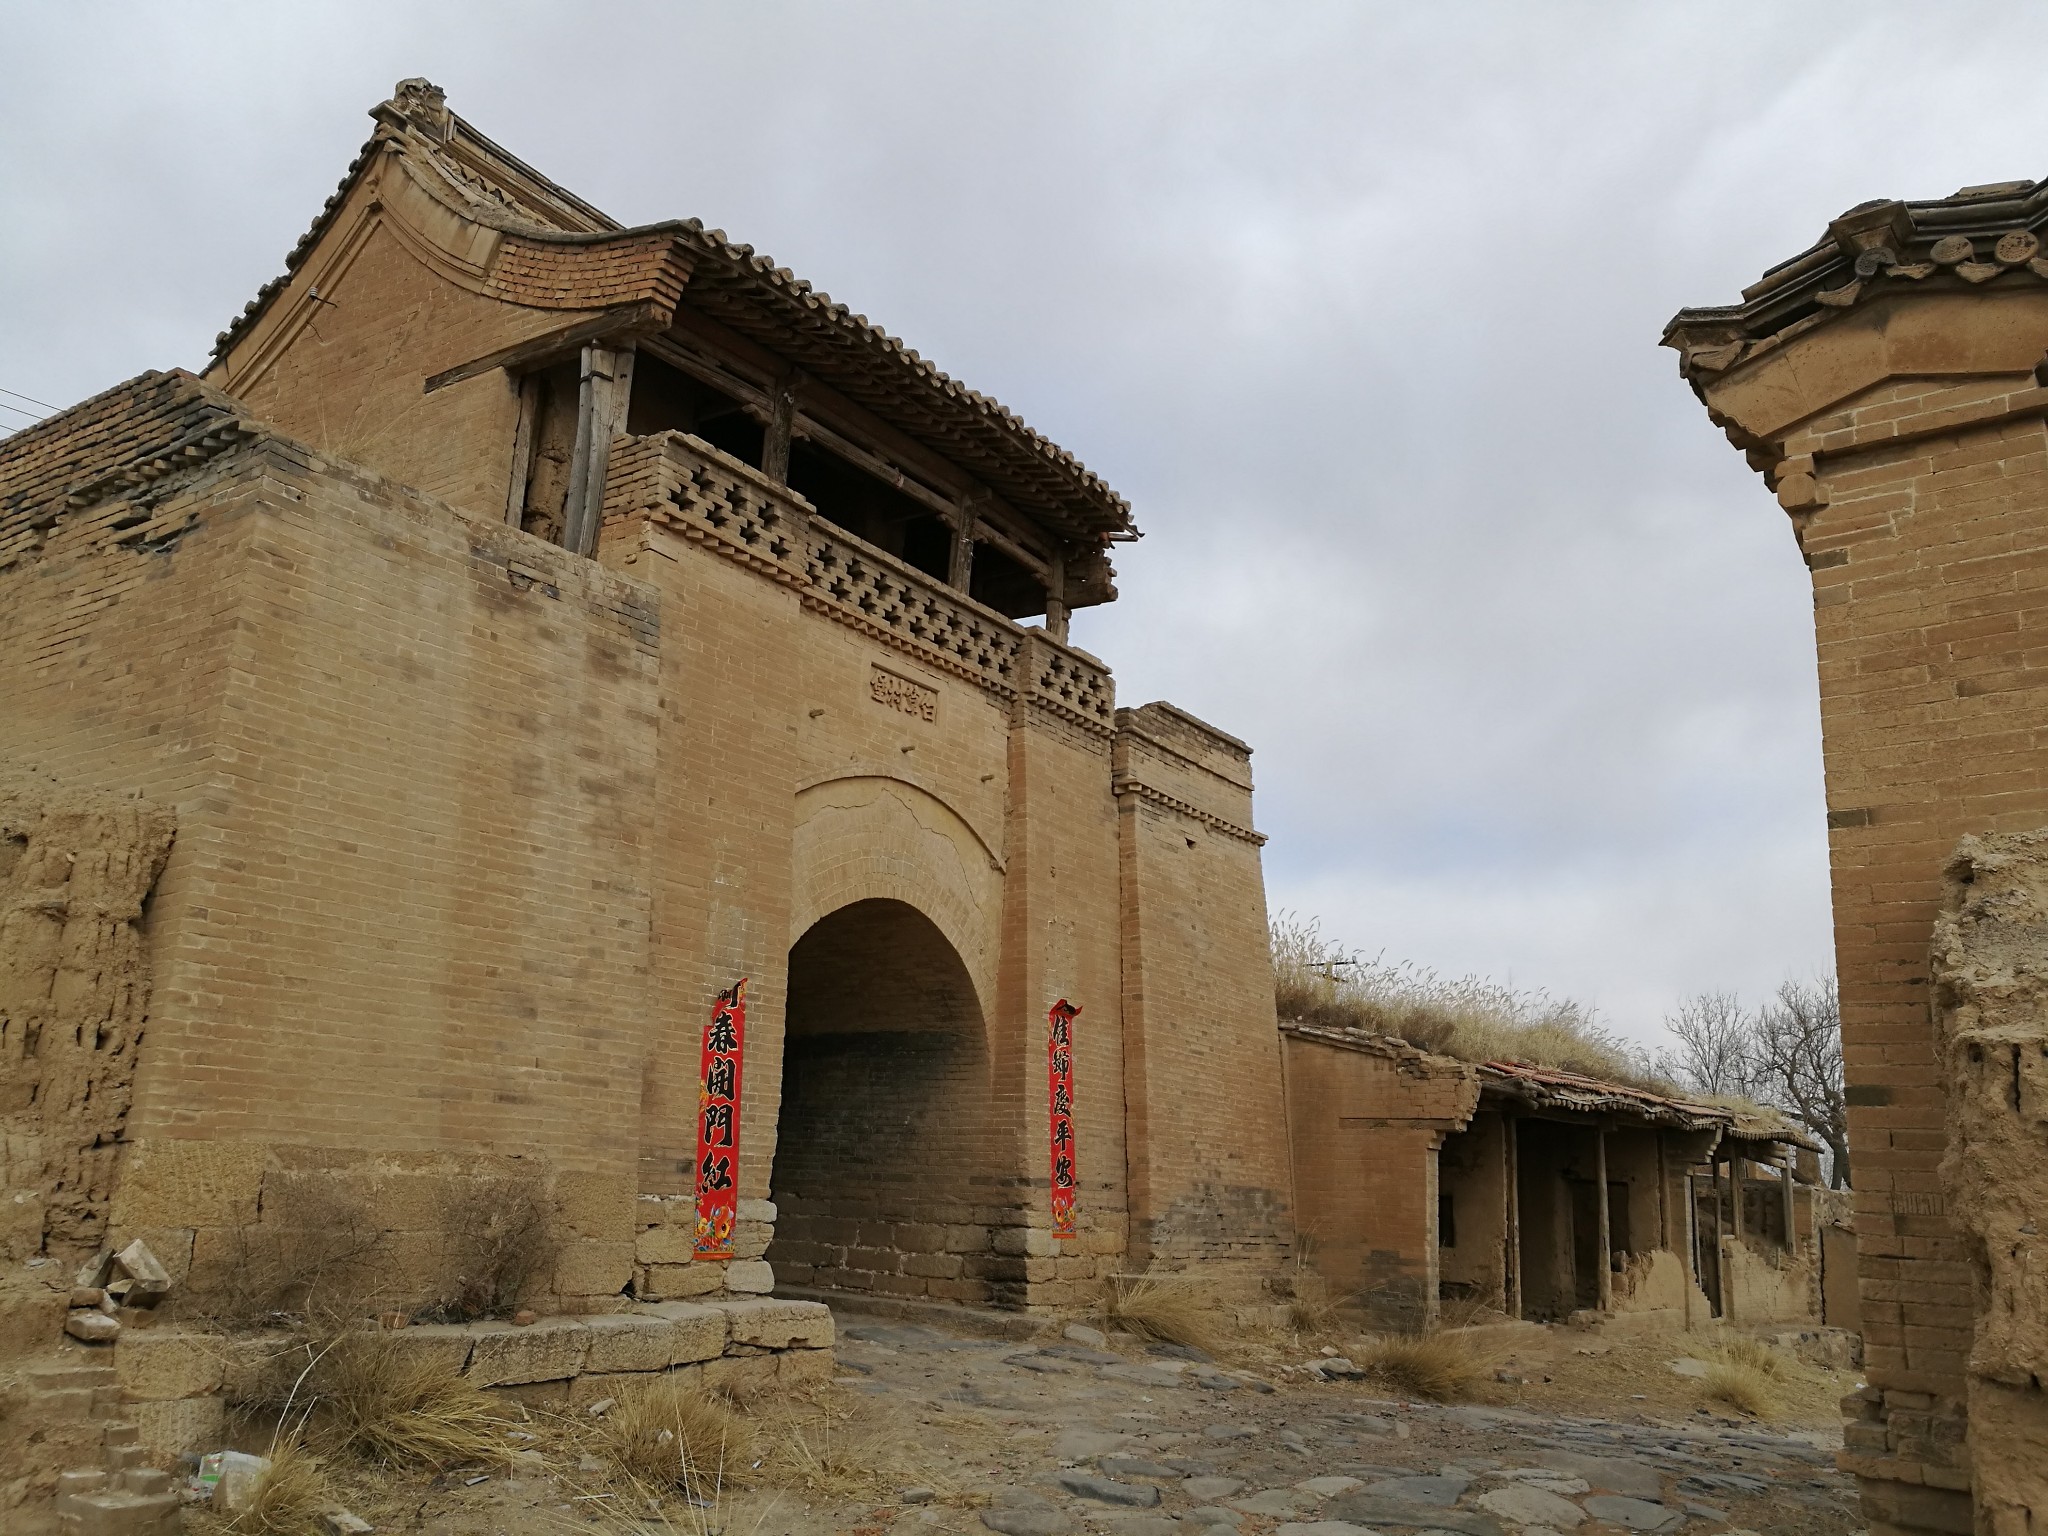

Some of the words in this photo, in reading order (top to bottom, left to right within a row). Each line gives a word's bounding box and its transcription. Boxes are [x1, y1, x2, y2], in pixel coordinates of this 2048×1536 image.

[1052, 1003, 1076, 1188] 佳節慶平安
